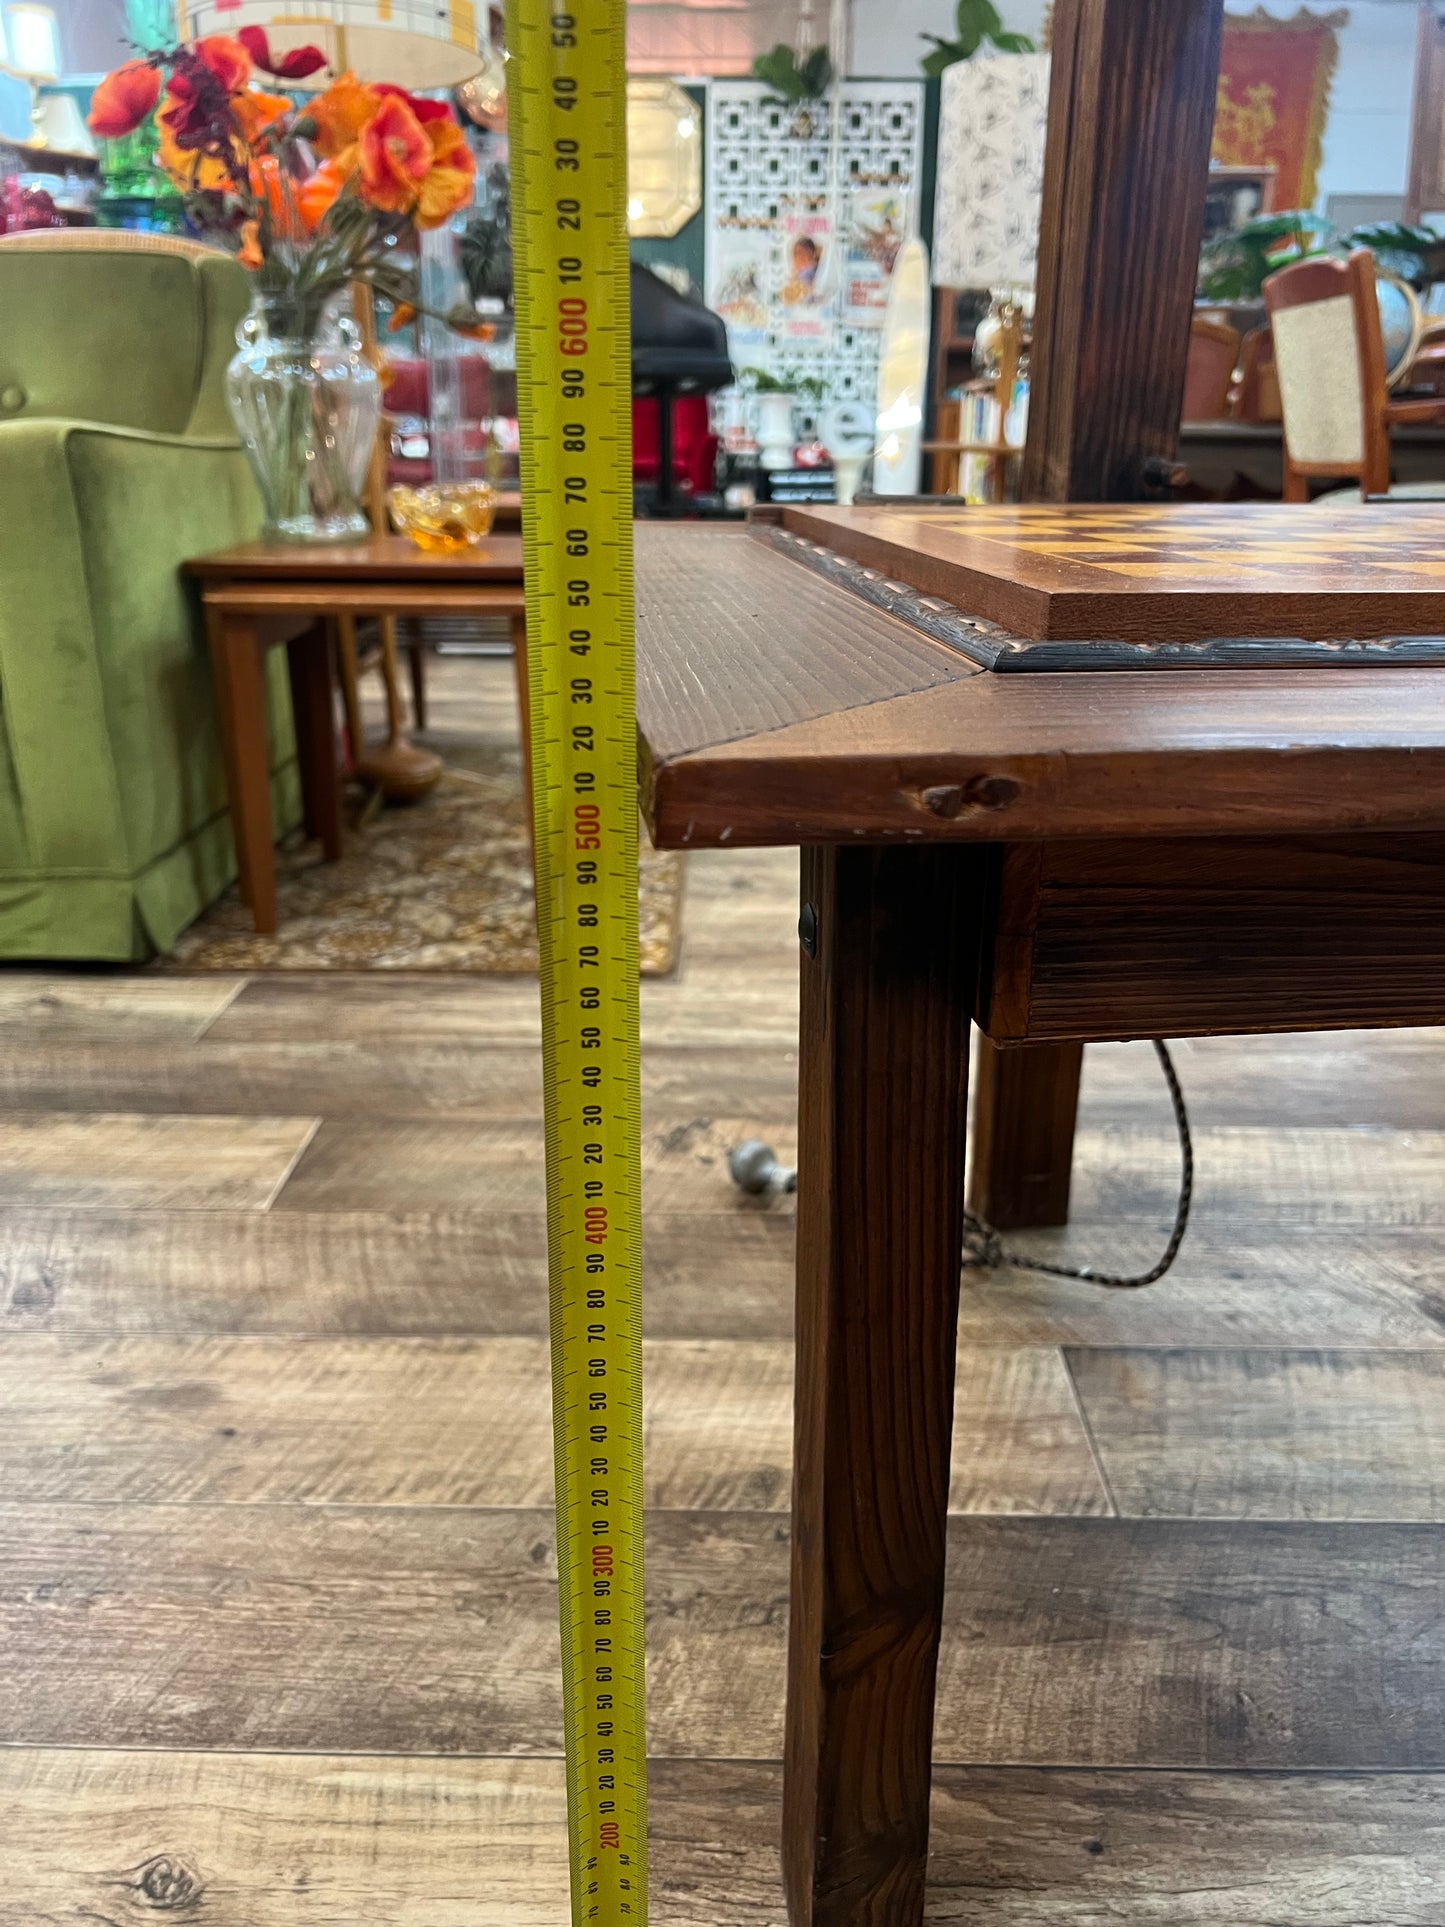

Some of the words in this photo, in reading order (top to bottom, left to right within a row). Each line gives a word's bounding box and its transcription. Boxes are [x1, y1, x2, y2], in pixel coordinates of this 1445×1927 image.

[551, 14, 577, 47] 50
[552, 77, 577, 111] 40
[555, 139, 579, 171] 30
[557, 199, 580, 230] 20
[558, 258, 582, 284] 10
[558, 298, 587, 356] 600
[561, 370, 584, 398] 90
[563, 424, 585, 452] 80
[564, 477, 586, 504] 70
[566, 529, 588, 556] 60
[568, 580, 589, 606] 50
[569, 630, 591, 656] 40
[570, 679, 592, 704] 30
[572, 726, 594, 751] 20
[574, 773, 595, 794] 10
[575, 805, 600, 849] 500
[576, 861, 597, 884] 90
[578, 904, 598, 927] 80
[579, 946, 599, 968] 70
[580, 987, 600, 1009] 60
[581, 1027, 600, 1048] 50
[582, 1067, 601, 1087] 40
[583, 1105, 602, 1126] 30
[584, 1144, 602, 1164] 20
[584, 1181, 603, 1199] 10
[584, 1207, 607, 1244] 400
[586, 1254, 604, 1273] 90
[587, 1290, 605, 1308] 80
[587, 1325, 605, 1343] 70
[588, 1359, 606, 1377] 60
[589, 1393, 606, 1410] 50
[590, 1426, 607, 1442] 40
[590, 1458, 608, 1475] 30
[591, 1490, 608, 1506] 20
[592, 1521, 609, 1536] 10
[592, 1545, 613, 1577] 300
[594, 1581, 610, 1596] 90
[594, 1610, 611, 1625] 80
[595, 1639, 612, 1653] 70
[596, 1667, 612, 1682] 60
[596, 1695, 613, 1709] 50
[597, 1722, 613, 1736] 40
[598, 1749, 614, 1764] 30
[599, 1776, 614, 1790] 20
[599, 1801, 615, 1814] 10
[600, 1822, 619, 1849] 200
[587, 1857, 597, 1870] 90
[619, 1854, 630, 1866] 90
[588, 1882, 598, 1894] 80
[620, 1879, 630, 1890] 80
[589, 1906, 599, 1919] 70
[620, 1903, 630, 1914] 70
